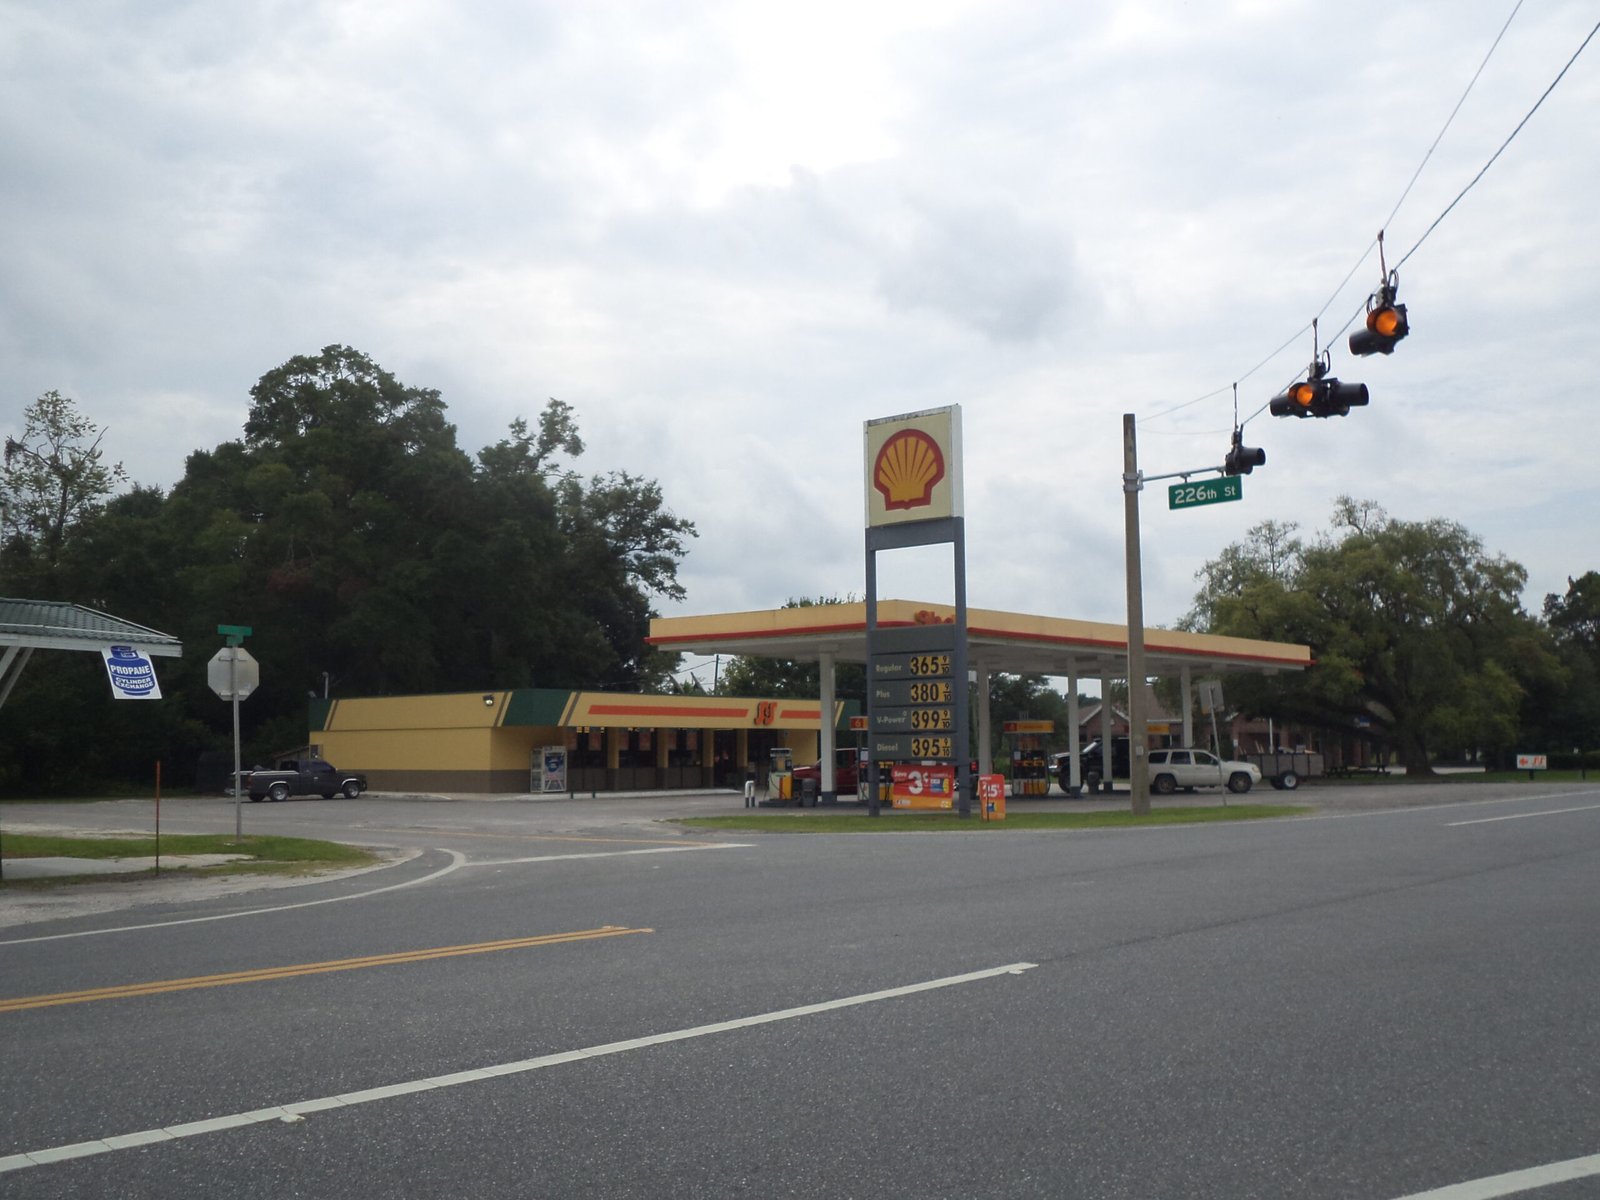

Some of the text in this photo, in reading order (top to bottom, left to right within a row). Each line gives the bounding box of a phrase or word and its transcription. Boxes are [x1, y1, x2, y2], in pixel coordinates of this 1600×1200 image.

[1175, 486, 1236, 504] 226th St
[110, 665, 151, 675] PROPANE
[875, 664, 902, 674] Regular
[910, 656, 939, 675] 365
[115, 681, 154, 689] EXCHANGE
[876, 690, 890, 698] Plus
[911, 683, 939, 701] 380
[912, 711, 940, 728] 399
[877, 743, 898, 752] Diesel
[912, 739, 940, 757] 395
